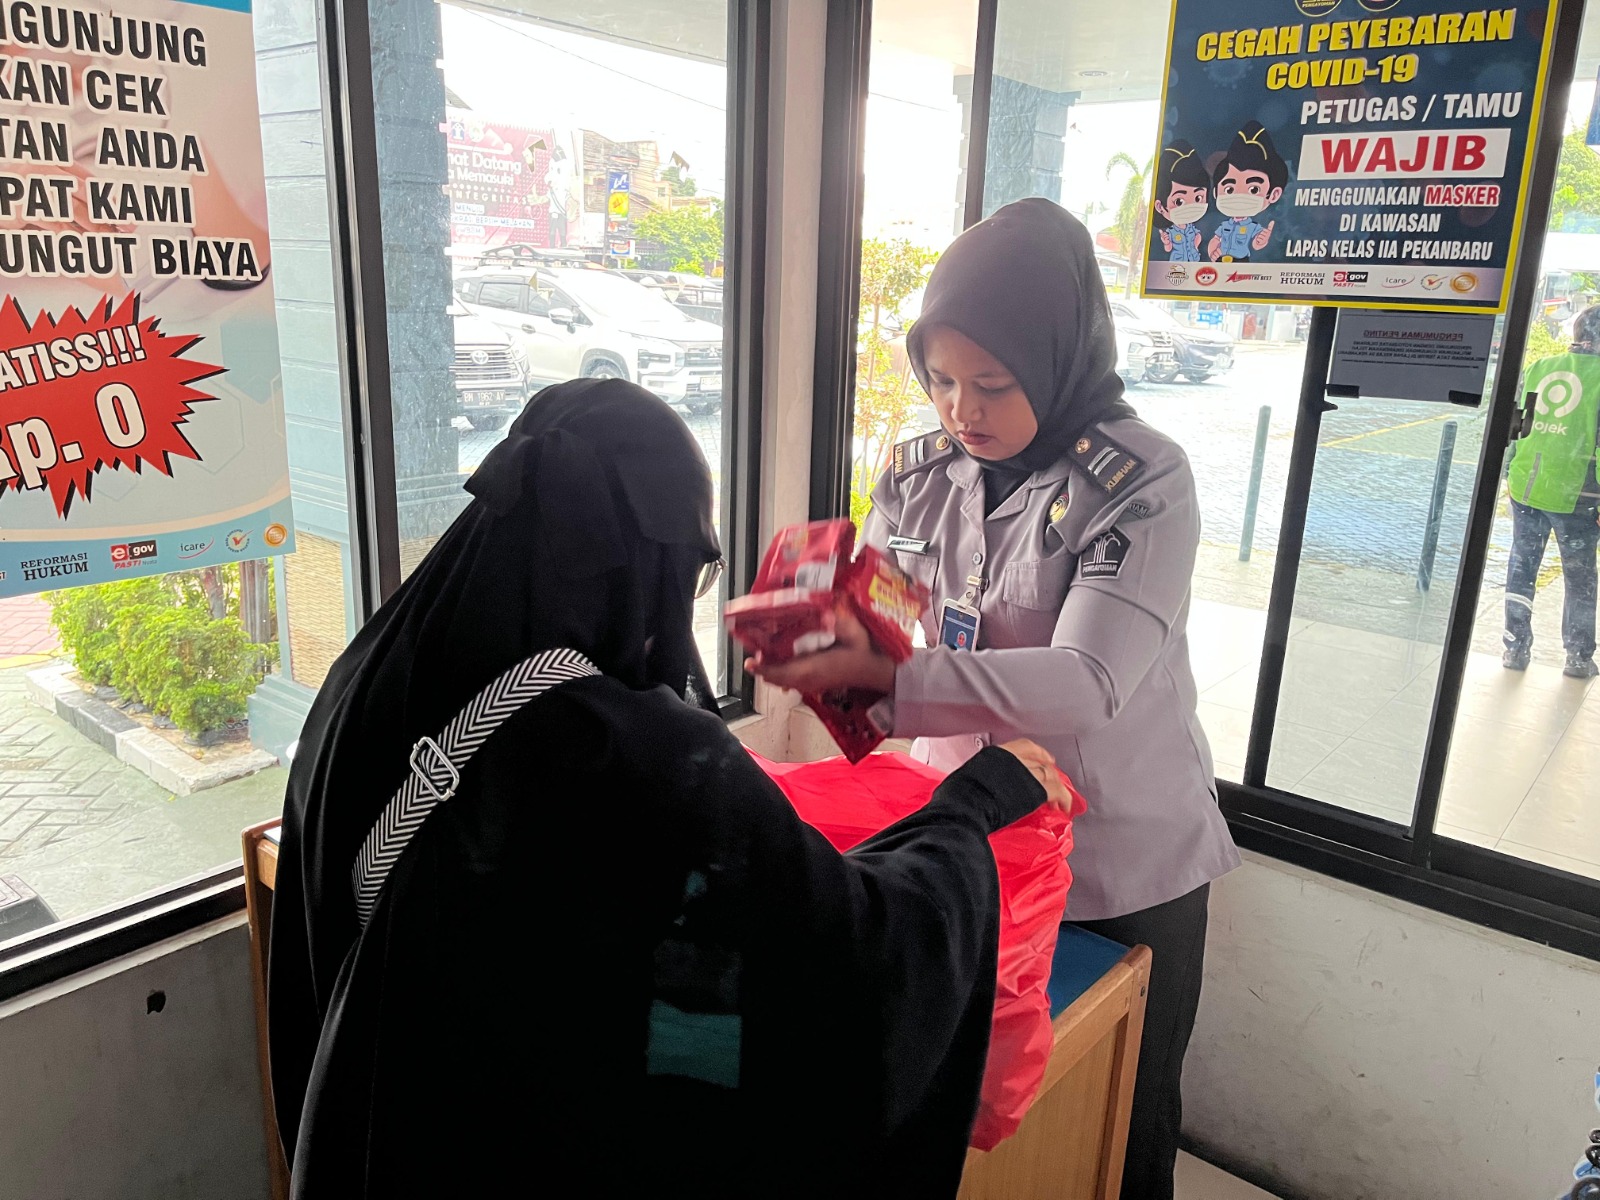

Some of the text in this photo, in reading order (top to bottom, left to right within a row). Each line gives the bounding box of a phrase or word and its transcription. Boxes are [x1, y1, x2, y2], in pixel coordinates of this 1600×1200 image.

[0, 1, 207, 67] GUNJUNG
[1196, 8, 1517, 62] CEGAH PEYEBARAN
[1266, 53, 1419, 91] COVID-19
[86, 69, 167, 116] CEK
[1301, 95, 1418, 125] PETUGAS
[1443, 92, 1522, 119] TAMU
[99, 127, 205, 173] ANDA
[1321, 135, 1486, 174] WAJIB
[472, 151, 521, 175] Datang
[0, 176, 193, 224] PAT KAMI
[1295, 185, 1500, 207] MENGGUNAKAN MASKER
[1339, 213, 1441, 233] DI KAWASAN
[0, 233, 258, 277] UNGUT BIAYA
[1286, 240, 1493, 260] LAPAS KELAS IIA PEKANBARU
[1280, 277, 1324, 286] HUKUM
[1350, 273, 1367, 281] gov
[0, 324, 147, 391] ATISS!!!
[95, 382, 147, 448] 0
[1532, 421, 1568, 436] ojek
[132, 543, 155, 556] gov
[180, 541, 206, 552] icare
[20, 552, 88, 569] REFORMASI
[24, 561, 89, 581] HUKUM
[114, 559, 141, 569] PASTI
